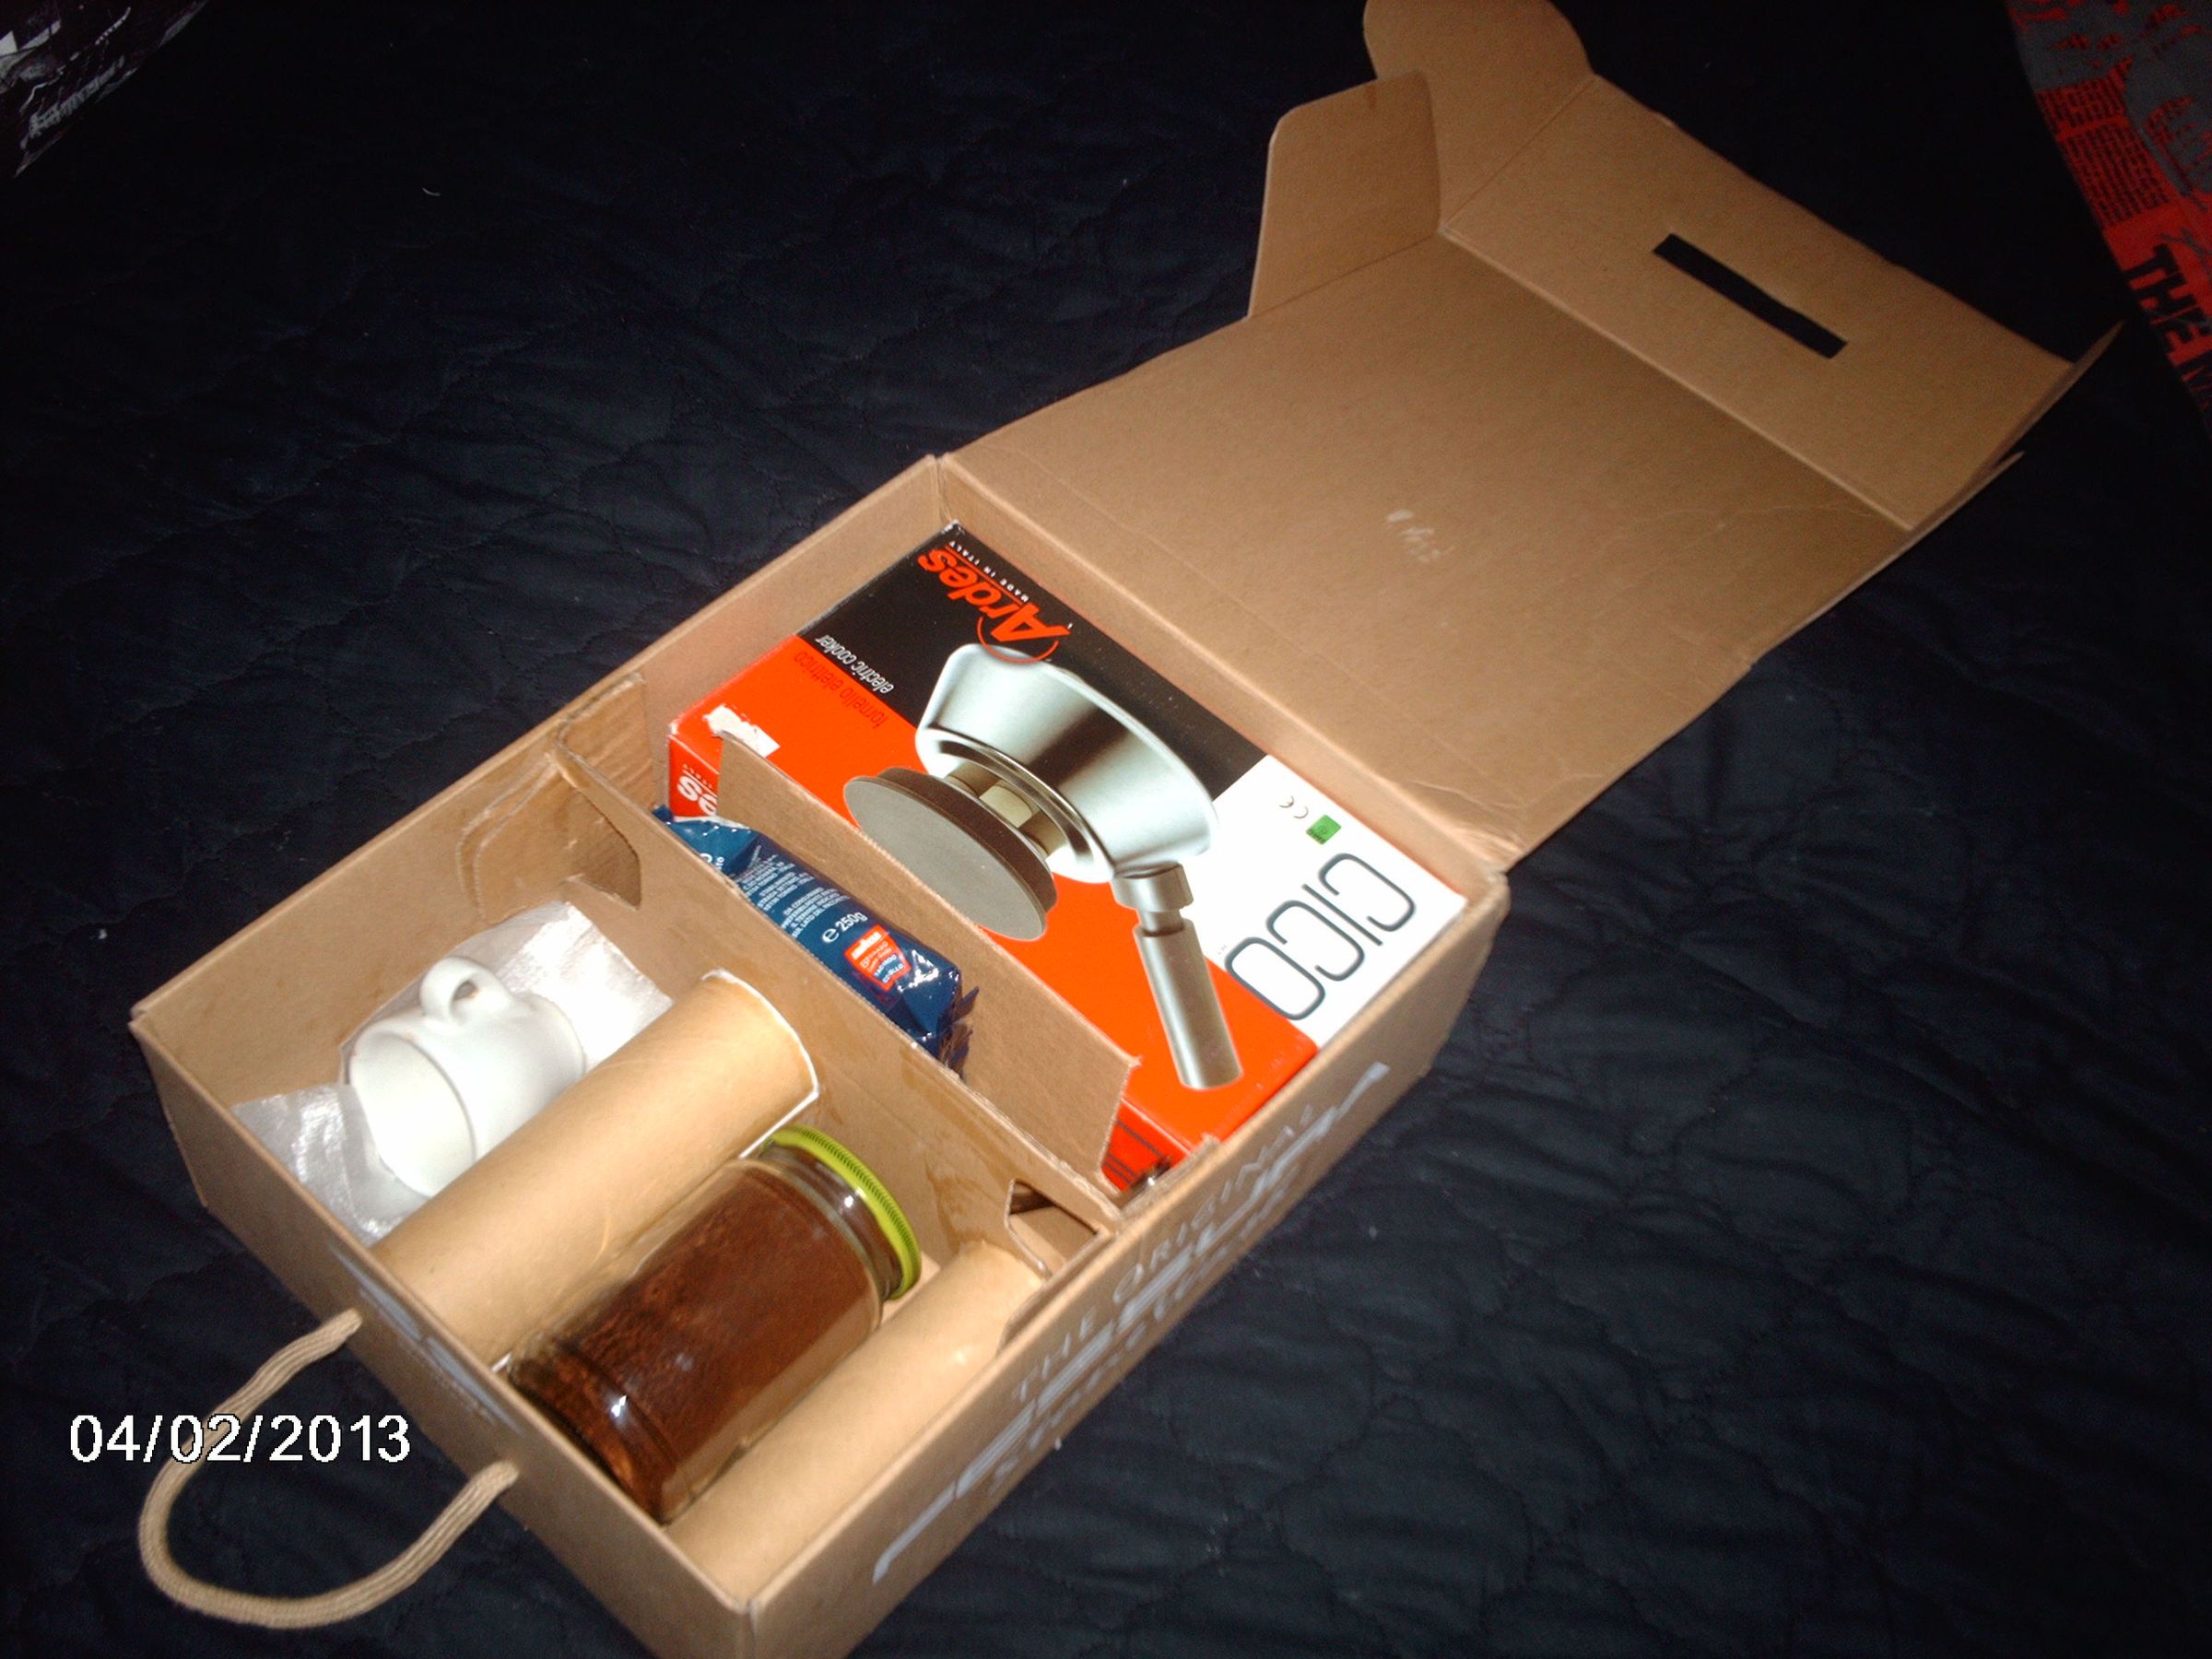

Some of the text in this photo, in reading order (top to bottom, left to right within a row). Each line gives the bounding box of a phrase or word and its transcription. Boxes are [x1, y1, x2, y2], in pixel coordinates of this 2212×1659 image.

[918, 548, 1071, 642] Ardes
[949, 540, 1030, 602] MADE IN ITALY
[794, 651, 888, 729] fornello elettrico
[815, 635, 894, 693] electric cooker
[835, 912, 868, 932] 250g
[1225, 853, 1416, 1020] CICO
